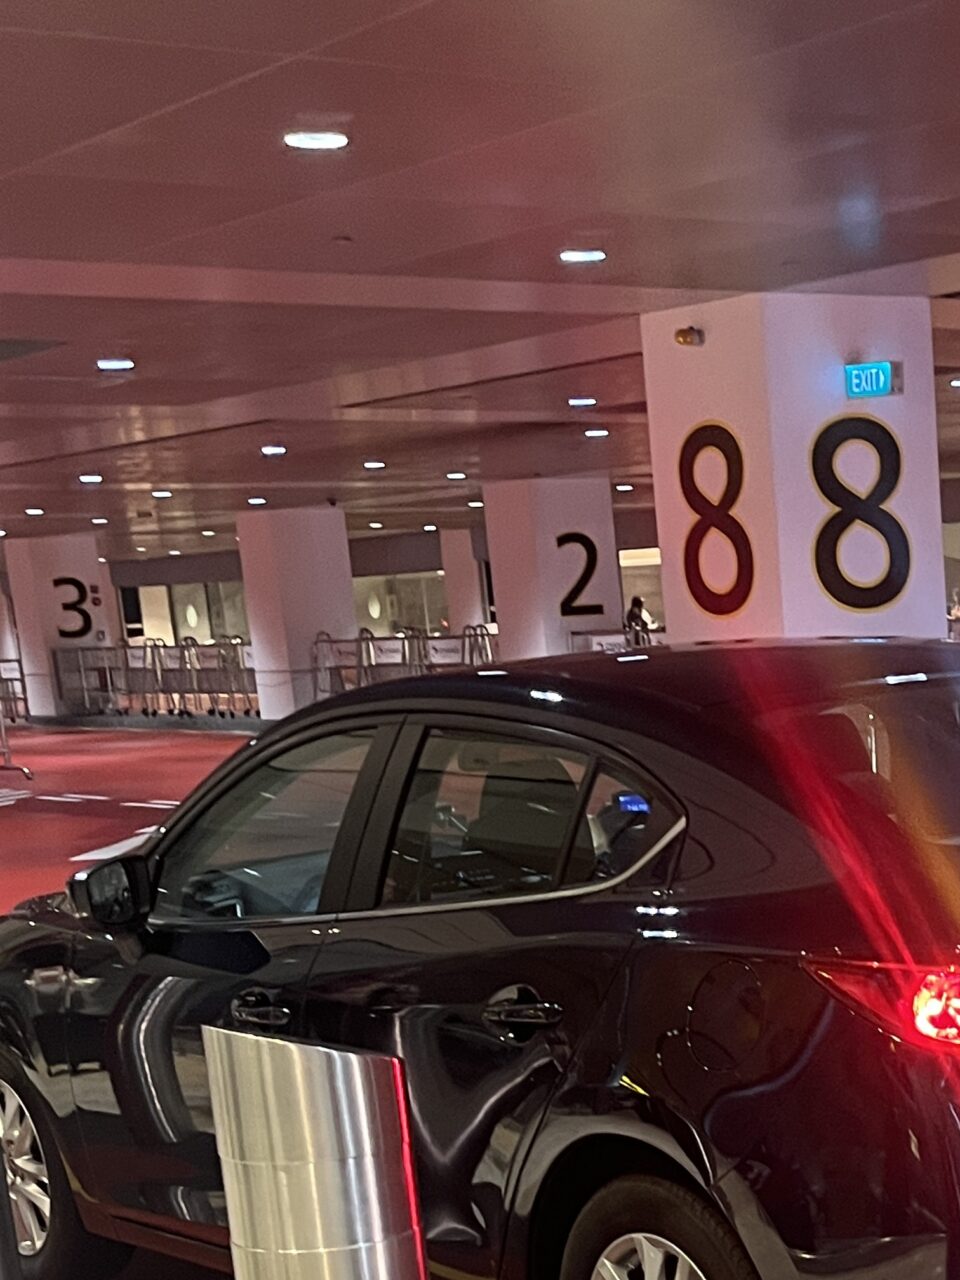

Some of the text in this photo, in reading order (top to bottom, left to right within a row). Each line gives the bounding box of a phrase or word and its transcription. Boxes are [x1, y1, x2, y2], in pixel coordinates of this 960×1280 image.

[851, 368, 878, 393] EXIT
[679, 424, 754, 615] 8
[811, 416, 910, 609] 8
[53, 577, 92, 638] 3
[557, 532, 604, 616] 2
